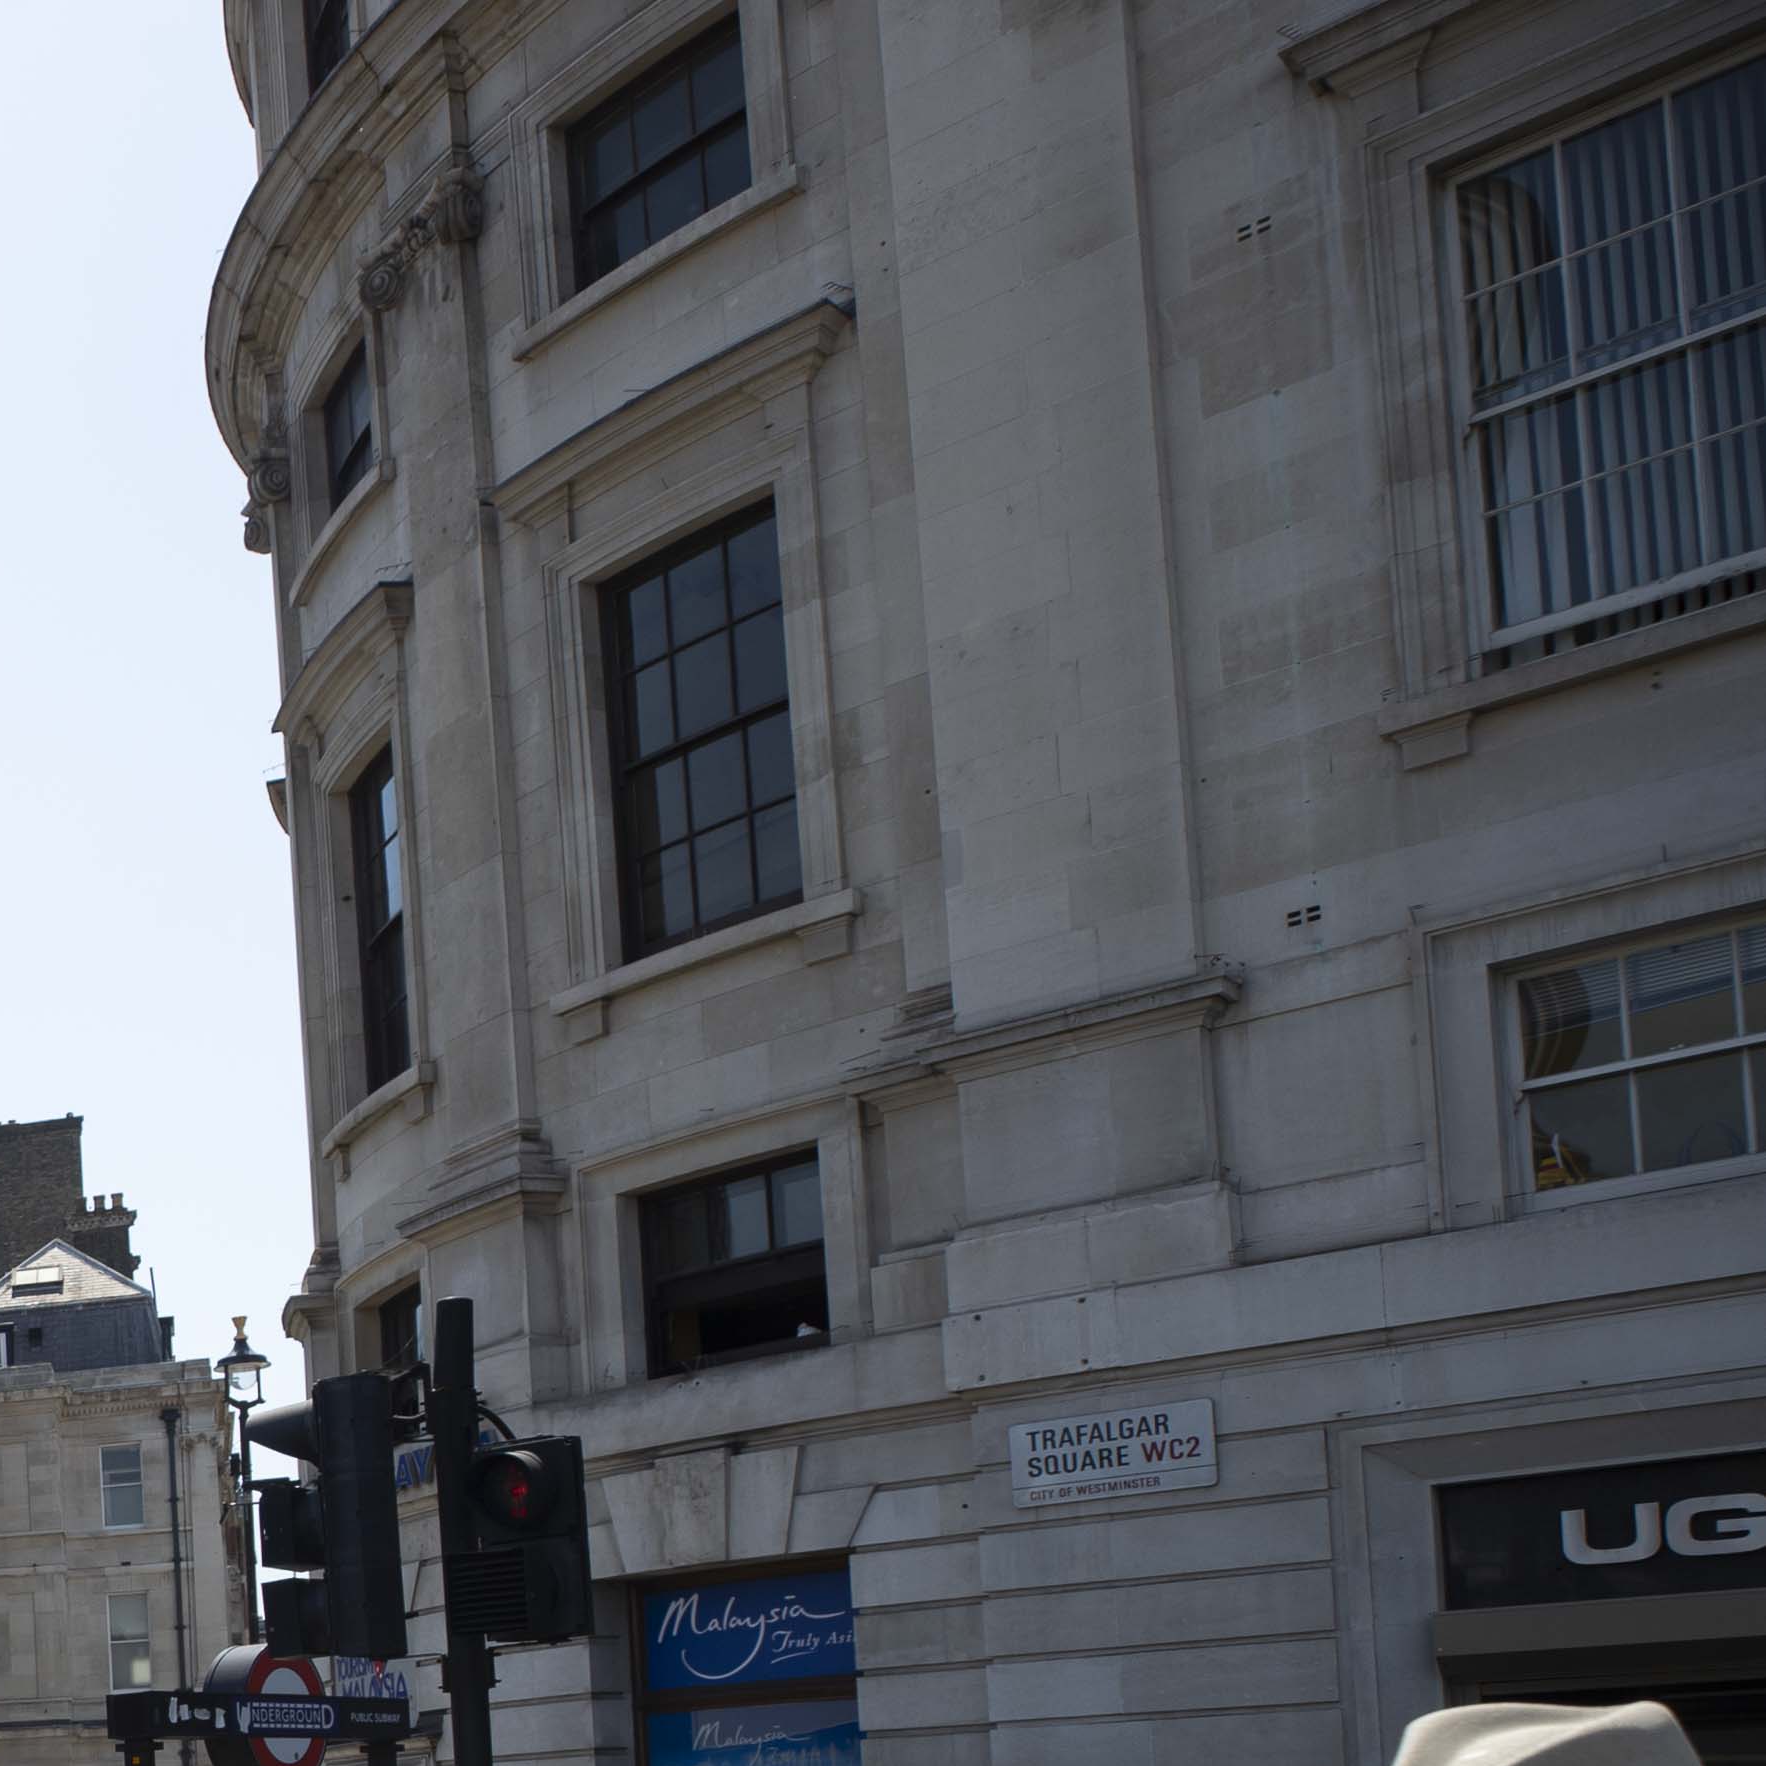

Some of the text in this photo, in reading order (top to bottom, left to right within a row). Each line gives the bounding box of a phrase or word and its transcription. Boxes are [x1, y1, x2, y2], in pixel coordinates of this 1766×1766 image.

[1026, 1413, 1171, 1453] TRAFALGAR
[1028, 1435, 1202, 1478] SQUARE WC2
[1029, 1476, 1162, 1501] CITY OF WESTMINSTER
[658, 1592, 846, 1680] Malaysia
[771, 1629, 854, 1654] Truly Asi
